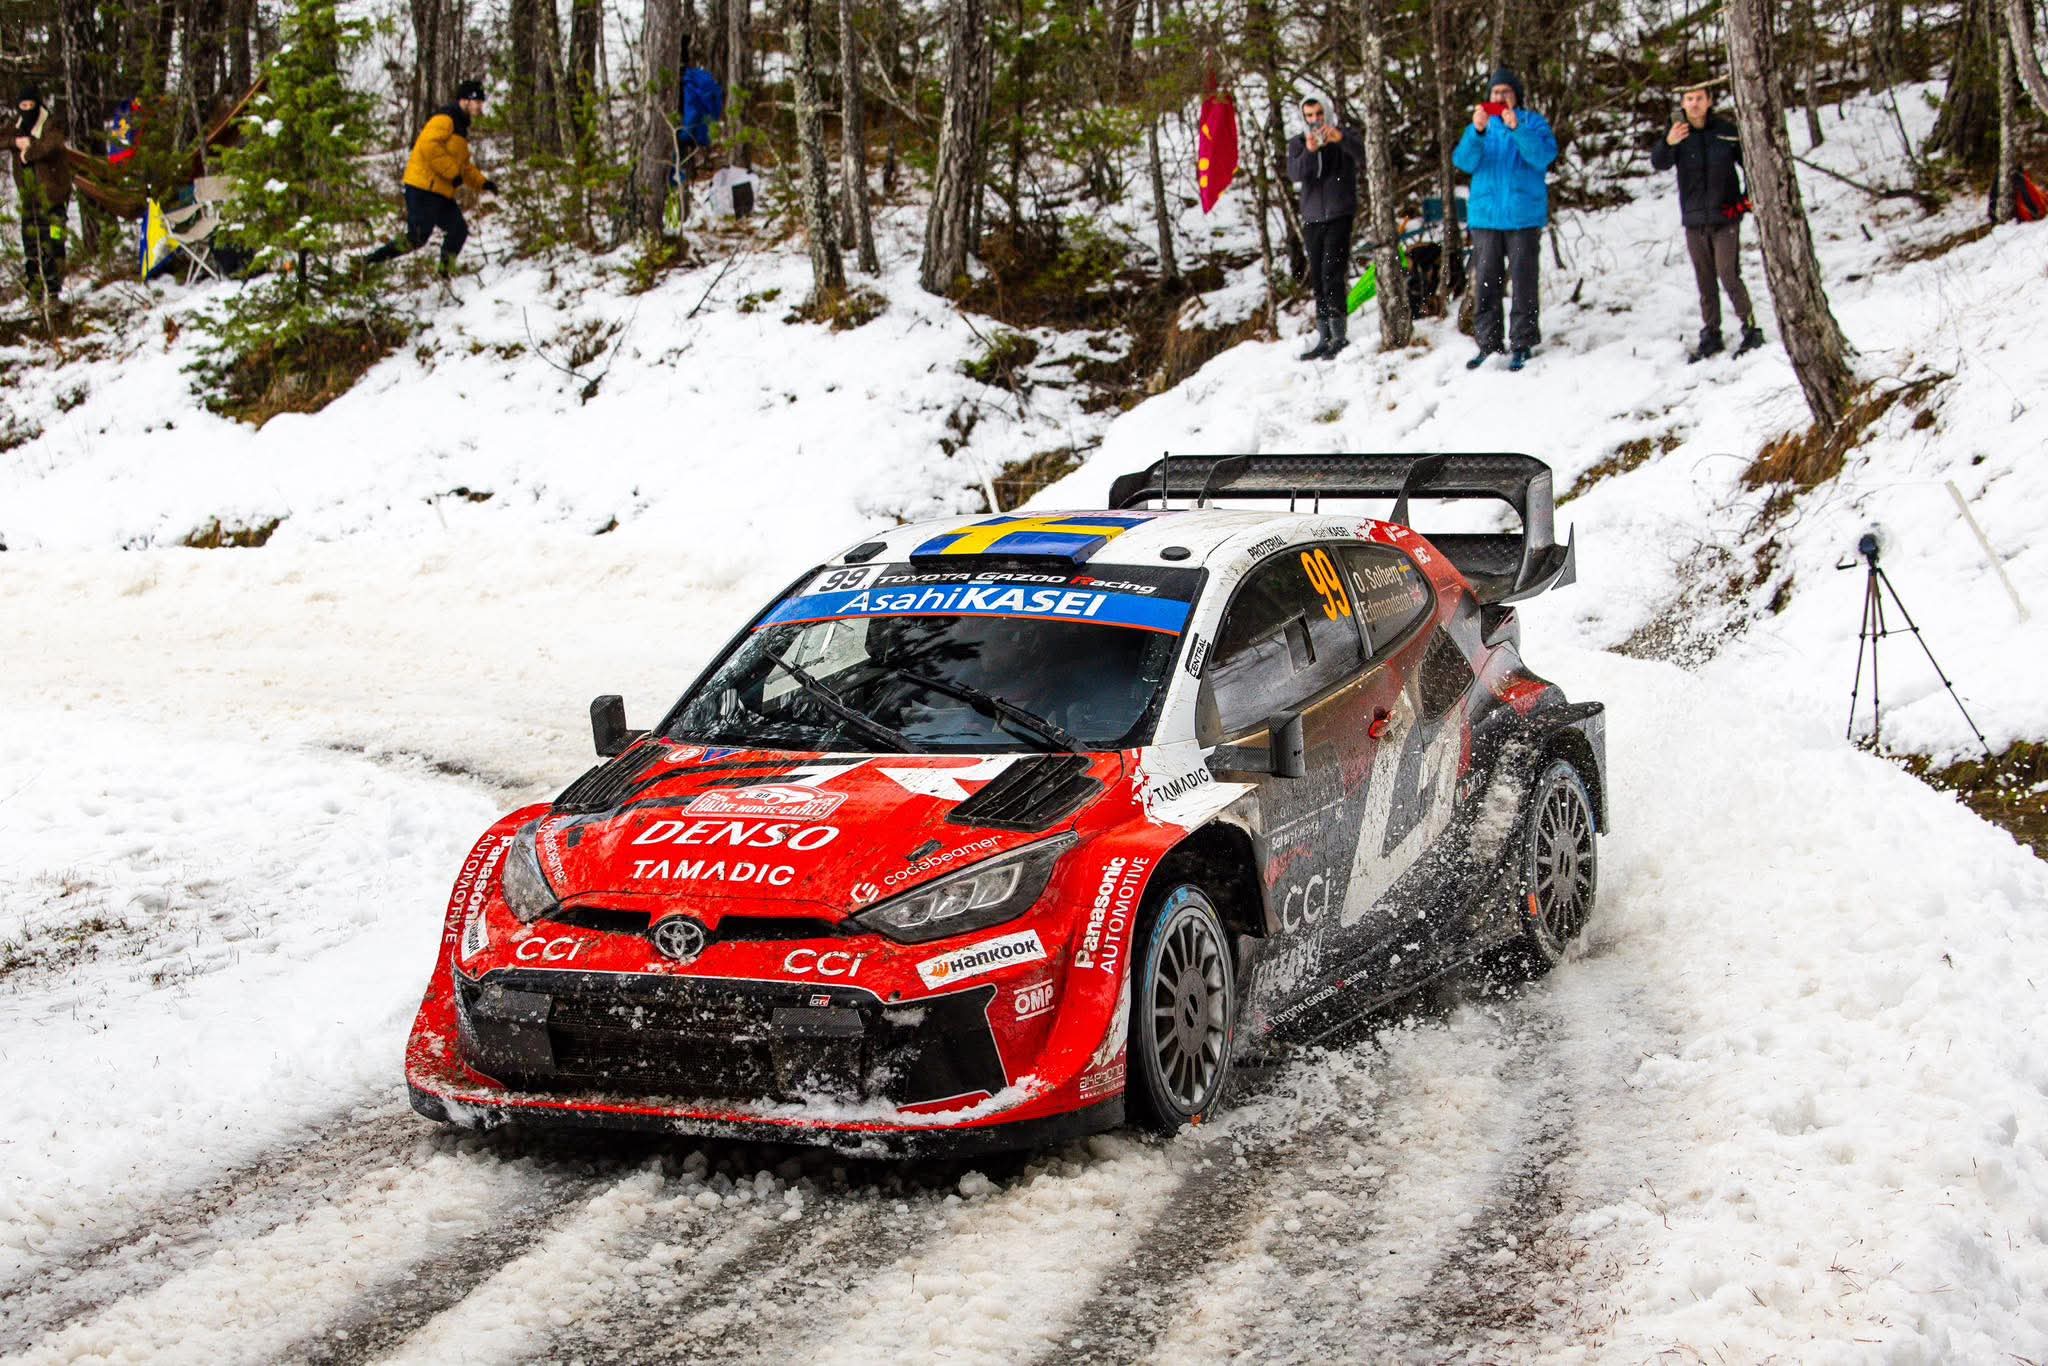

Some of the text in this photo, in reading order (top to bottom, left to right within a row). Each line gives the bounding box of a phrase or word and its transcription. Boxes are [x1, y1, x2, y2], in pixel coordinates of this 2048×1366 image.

[1247, 535, 1288, 560] PROTERIAL
[819, 567, 872, 592] 99
[880, 572, 1158, 594] TOYOTA GAZOO Racing
[1300, 548, 1352, 622] 99
[1364, 564, 1404, 590] Solberg
[1190, 639, 1207, 678] CENTRAL
[1153, 767, 1209, 802] TAMADIC
[631, 820, 840, 851] DENSO
[632, 859, 795, 886] TAMADIC
[884, 835, 1003, 886] codebeamer
[445, 833, 496, 943] AUTOMOTIVE
[1075, 856, 1127, 969] Panasonic
[1100, 856, 1150, 975] AUTOMOTIVE
[1014, 984, 1054, 1015] OMP
